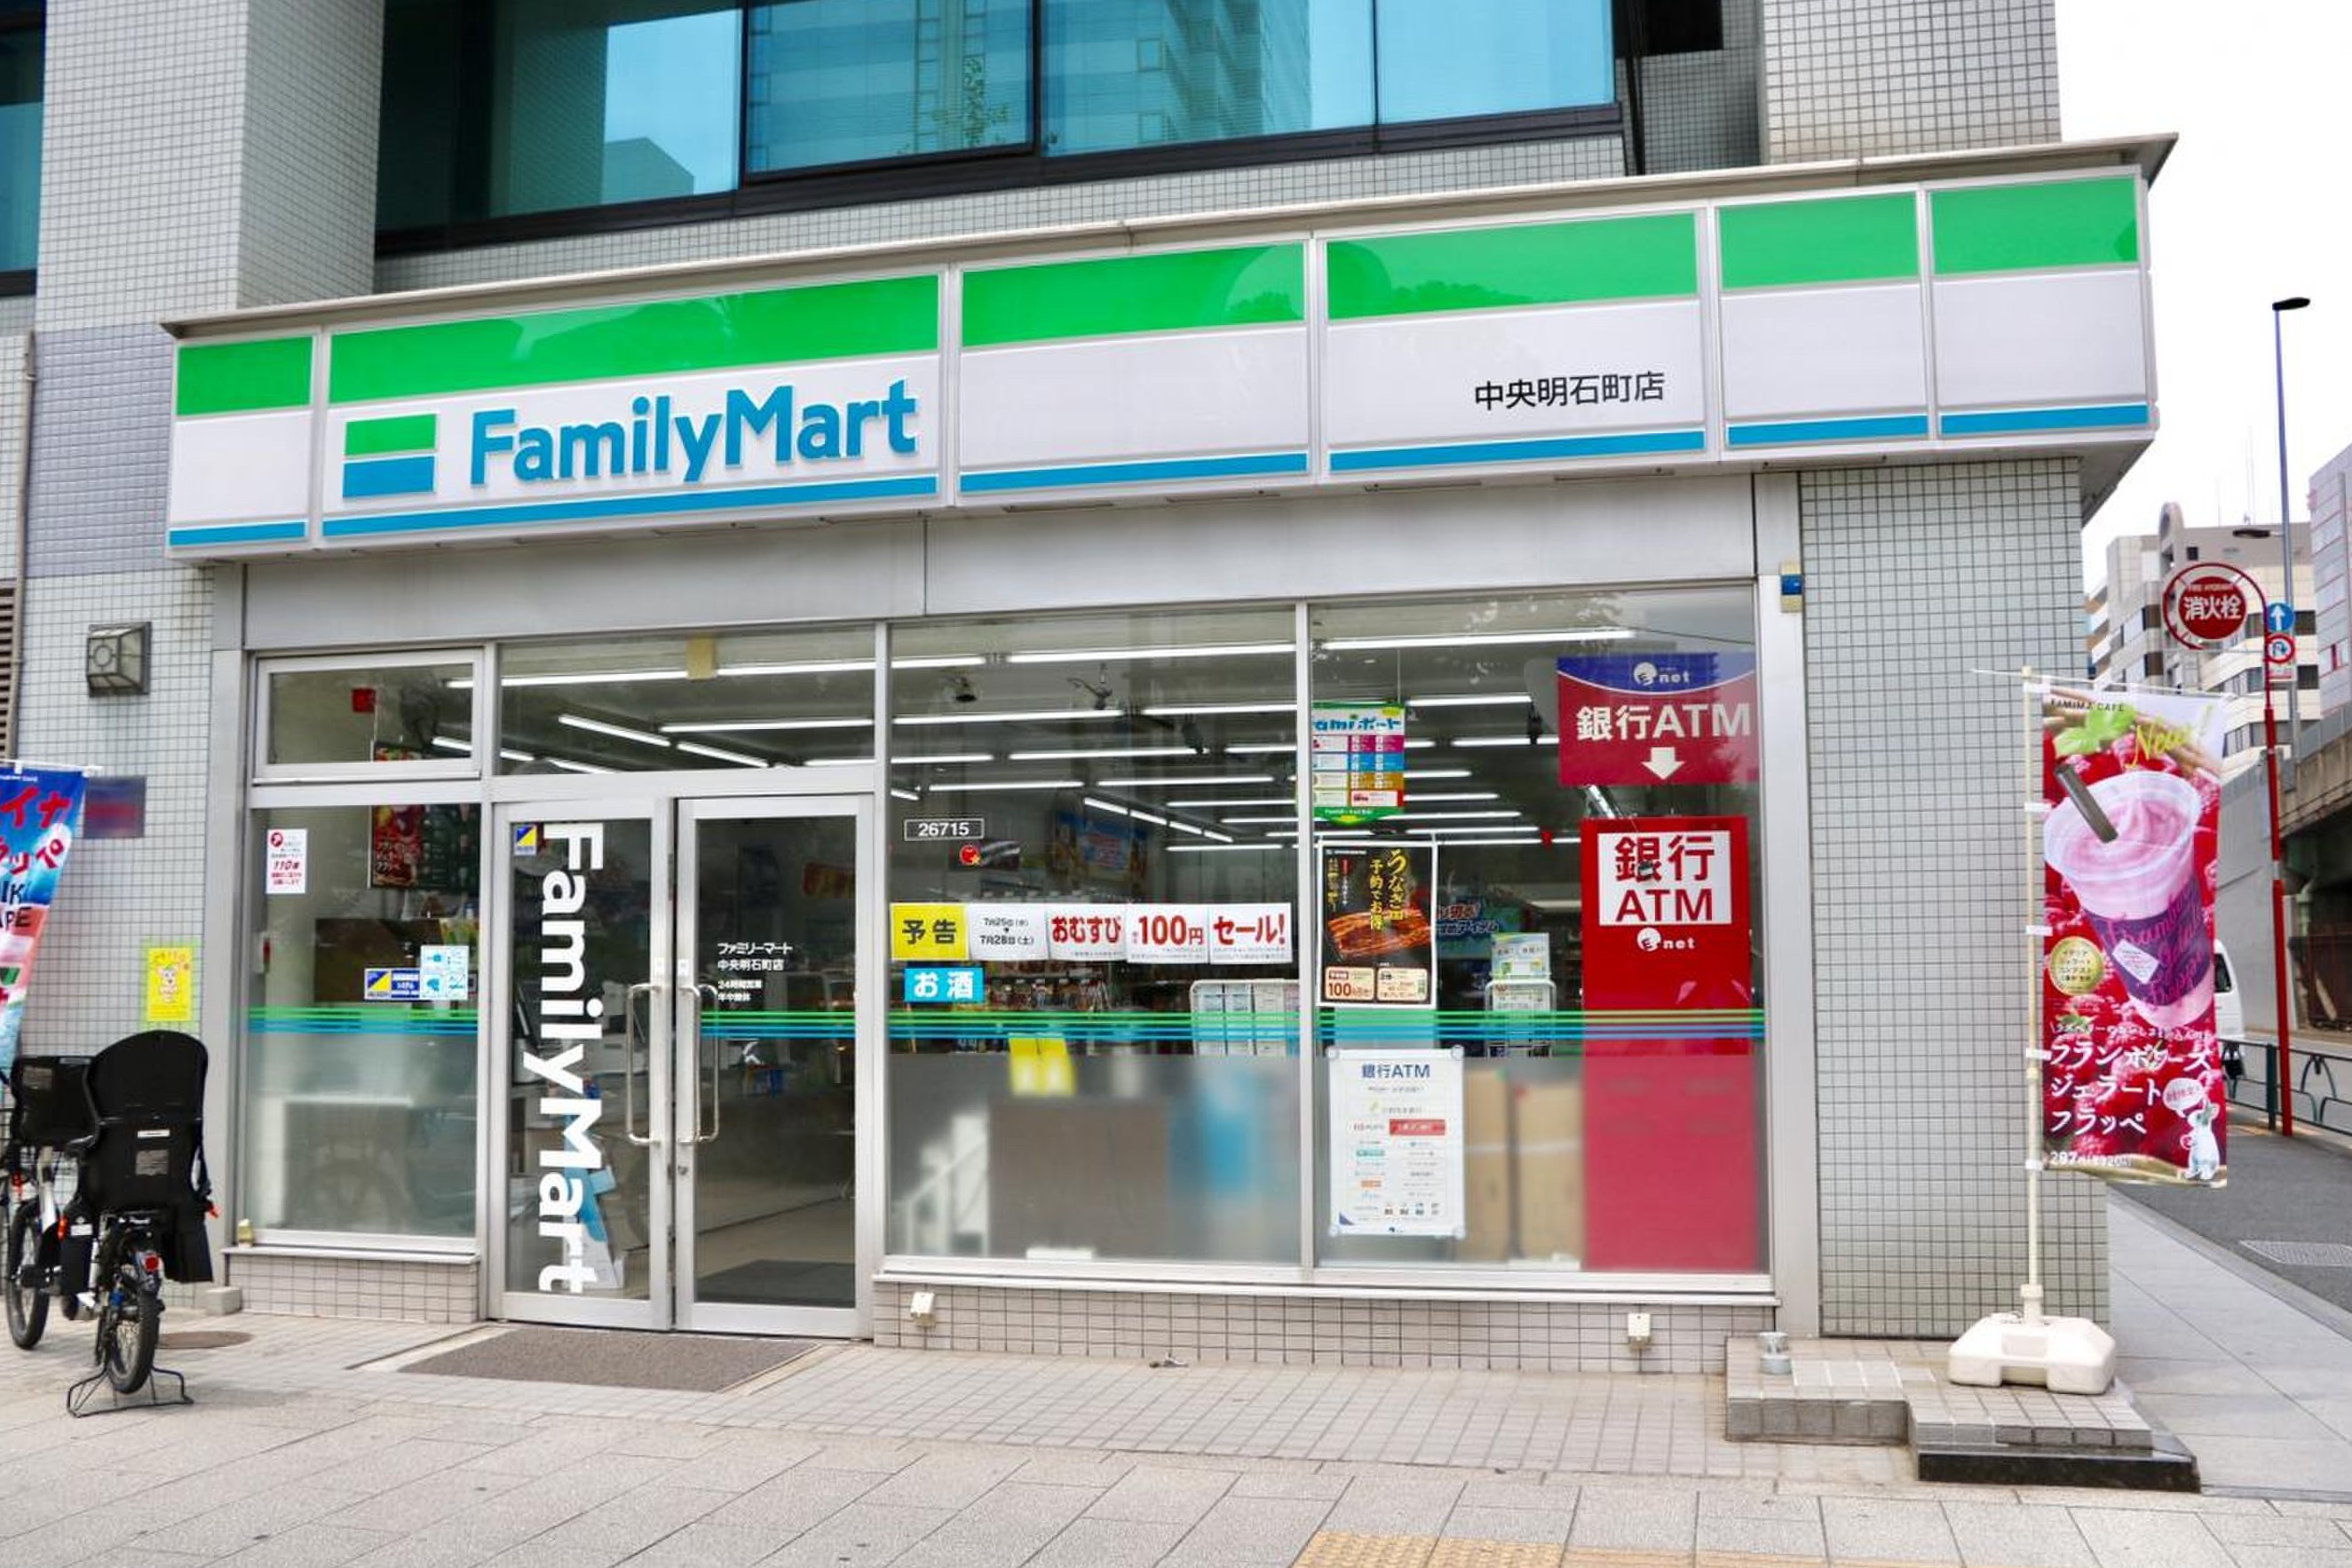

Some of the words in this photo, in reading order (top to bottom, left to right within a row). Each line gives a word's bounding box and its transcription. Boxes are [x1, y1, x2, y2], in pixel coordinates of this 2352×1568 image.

[1474, 371, 1666, 411] 中央明石町店
[470, 379, 917, 486] FamilyMart
[2183, 594, 2242, 621] 消火栓
[1576, 702, 1752, 741] 銀行ATM
[917, 821, 970, 838] 26715
[1614, 835, 1715, 883] 銀行
[1615, 889, 1713, 923] ATM
[901, 918, 957, 946] 予告
[1051, 915, 1122, 944] おむすび
[1138, 915, 1204, 946] 100円
[717, 941, 793, 955] ファミリーマート
[717, 958, 785, 971] 中央明石町店
[914, 971, 974, 998] お酒
[522, 821, 604, 1295] FamilyMart
[1361, 1063, 1430, 1079] 銀行ATM
[2050, 1073, 2161, 1106] ジェラート
[2050, 1106, 2148, 1136] フラッペ
